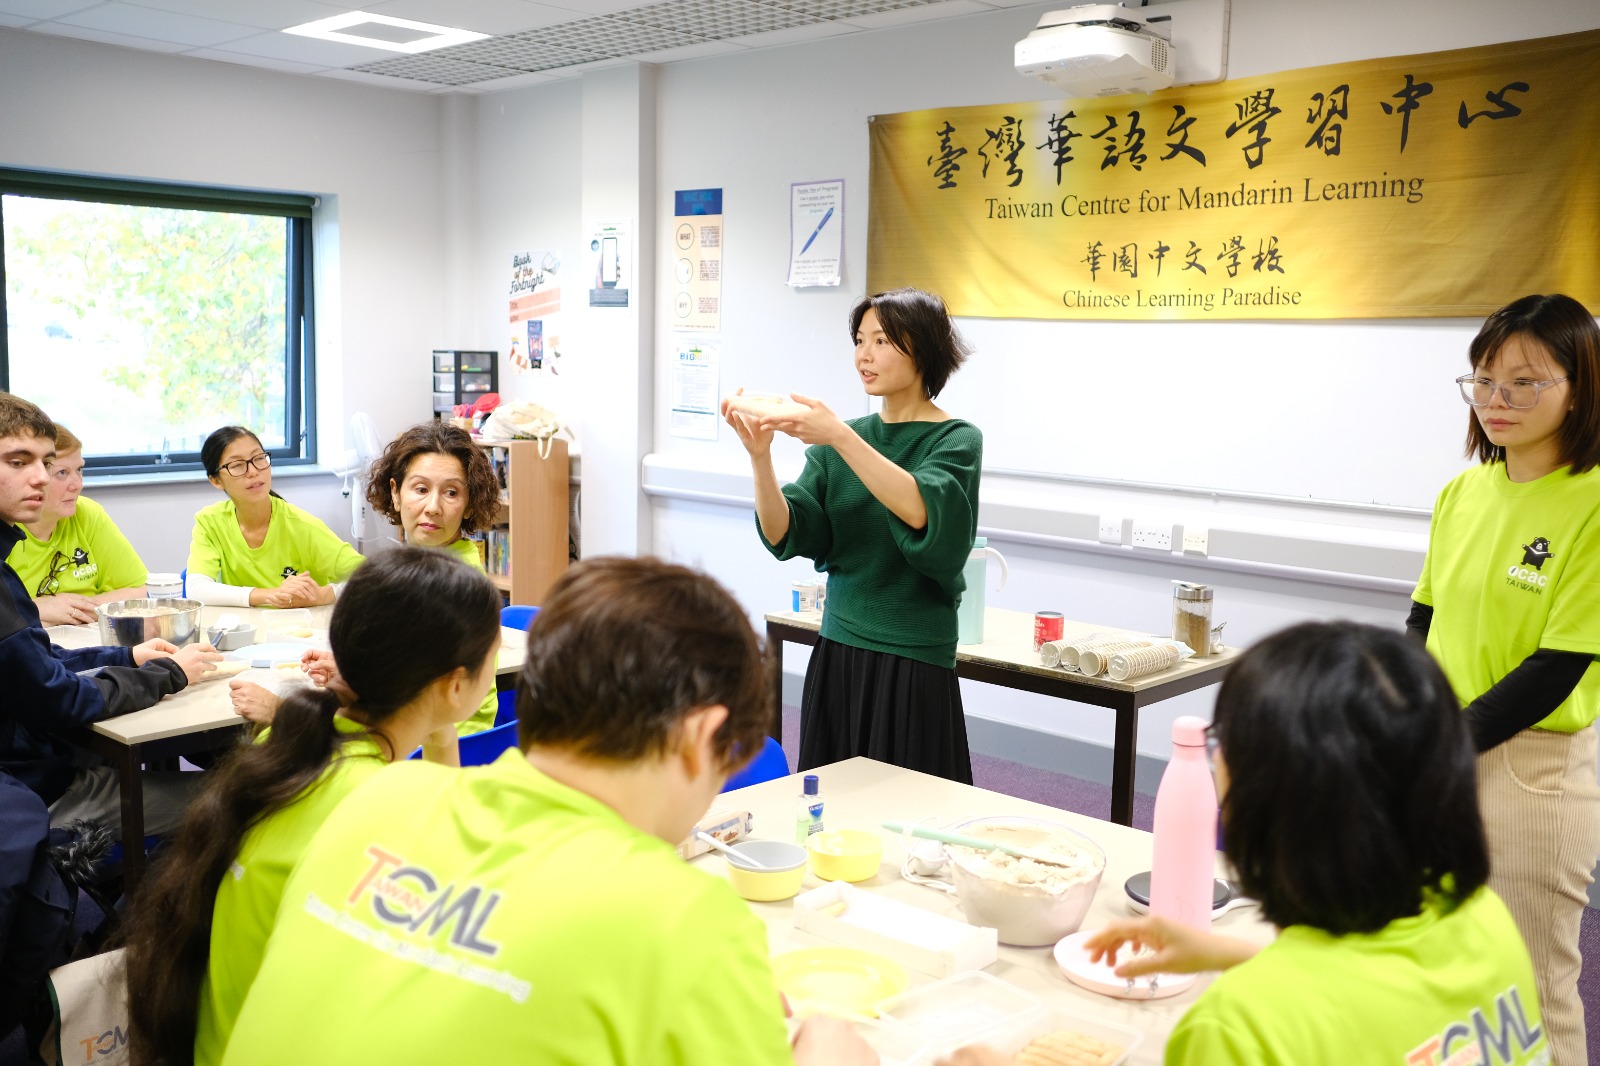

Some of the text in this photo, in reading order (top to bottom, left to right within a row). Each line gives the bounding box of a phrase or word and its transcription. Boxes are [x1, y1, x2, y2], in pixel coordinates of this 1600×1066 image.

[927, 74, 1530, 189] 臺灣華語文學習中心
[984, 171, 1425, 219] Taiwan Centre for Mandarin Learning
[513, 252, 531, 268] Book
[1080, 235, 1285, 282] 華園中文學校
[510, 271, 545, 294] Fortnight
[1063, 286, 1302, 311] Chinese Learning Paradise
[73, 564, 97, 577] ocac
[1508, 565, 1548, 587] ocac
[1506, 577, 1543, 595] TAIWAN
[80, 1026, 128, 1062] TCM
